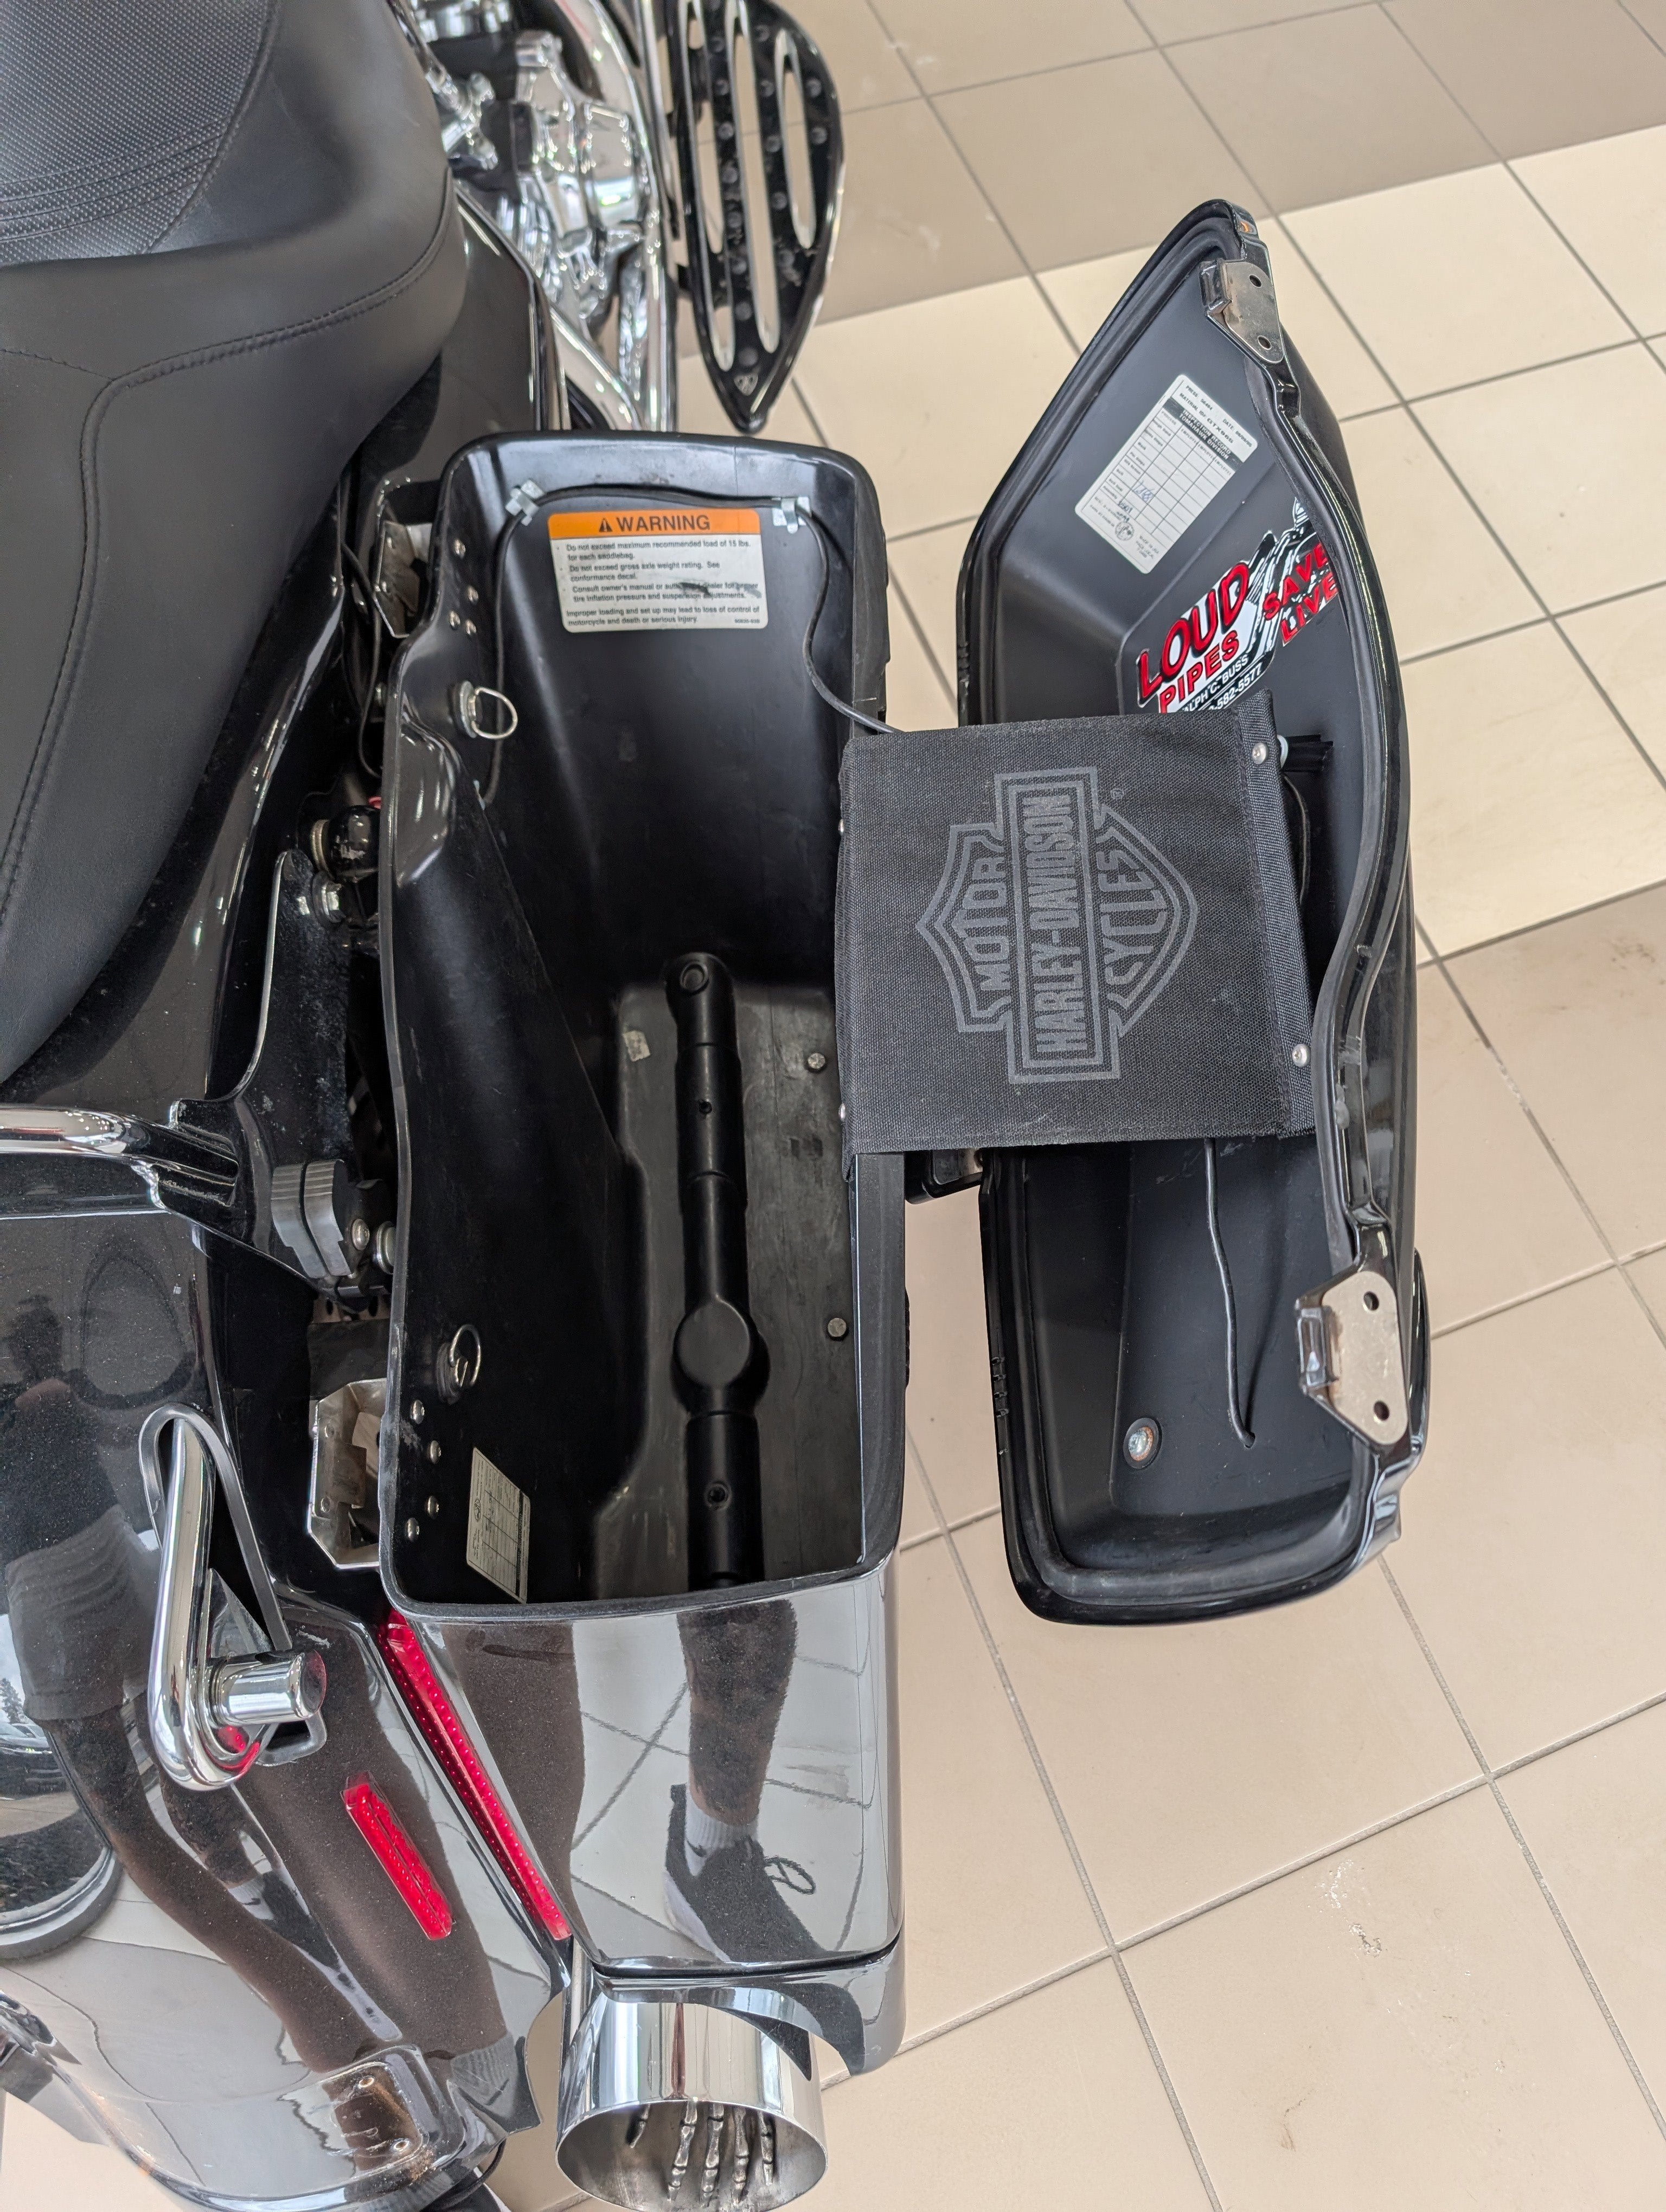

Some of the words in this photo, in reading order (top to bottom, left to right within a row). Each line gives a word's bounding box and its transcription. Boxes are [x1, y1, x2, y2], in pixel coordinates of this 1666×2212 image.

[1179, 393, 1198, 410] MATERIAL
[1178, 413, 1208, 440] TOMAHAWK
[1206, 439, 1229, 460] DIVISION
[1182, 409, 1212, 436] INSPECTION
[1210, 435, 1232, 454] RECORD
[616, 515, 710, 532] WARNING
[617, 542, 651, 550] maximum
[652, 540, 701, 549] recommended
[1263, 542, 1329, 620] SAVE
[568, 618, 606, 626] motorcycle
[598, 608, 624, 616] loading
[1280, 571, 1338, 643] LIVE
[1137, 562, 1250, 700] LOUD
[1159, 630, 1240, 714] PIPES
[1182, 689, 1209, 711] ALPH
[951, 856, 1011, 992] MOTOR
[1023, 794, 1089, 1052] HARLEY-DAVIDSON
[1097, 848, 1169, 987] CYCLES
